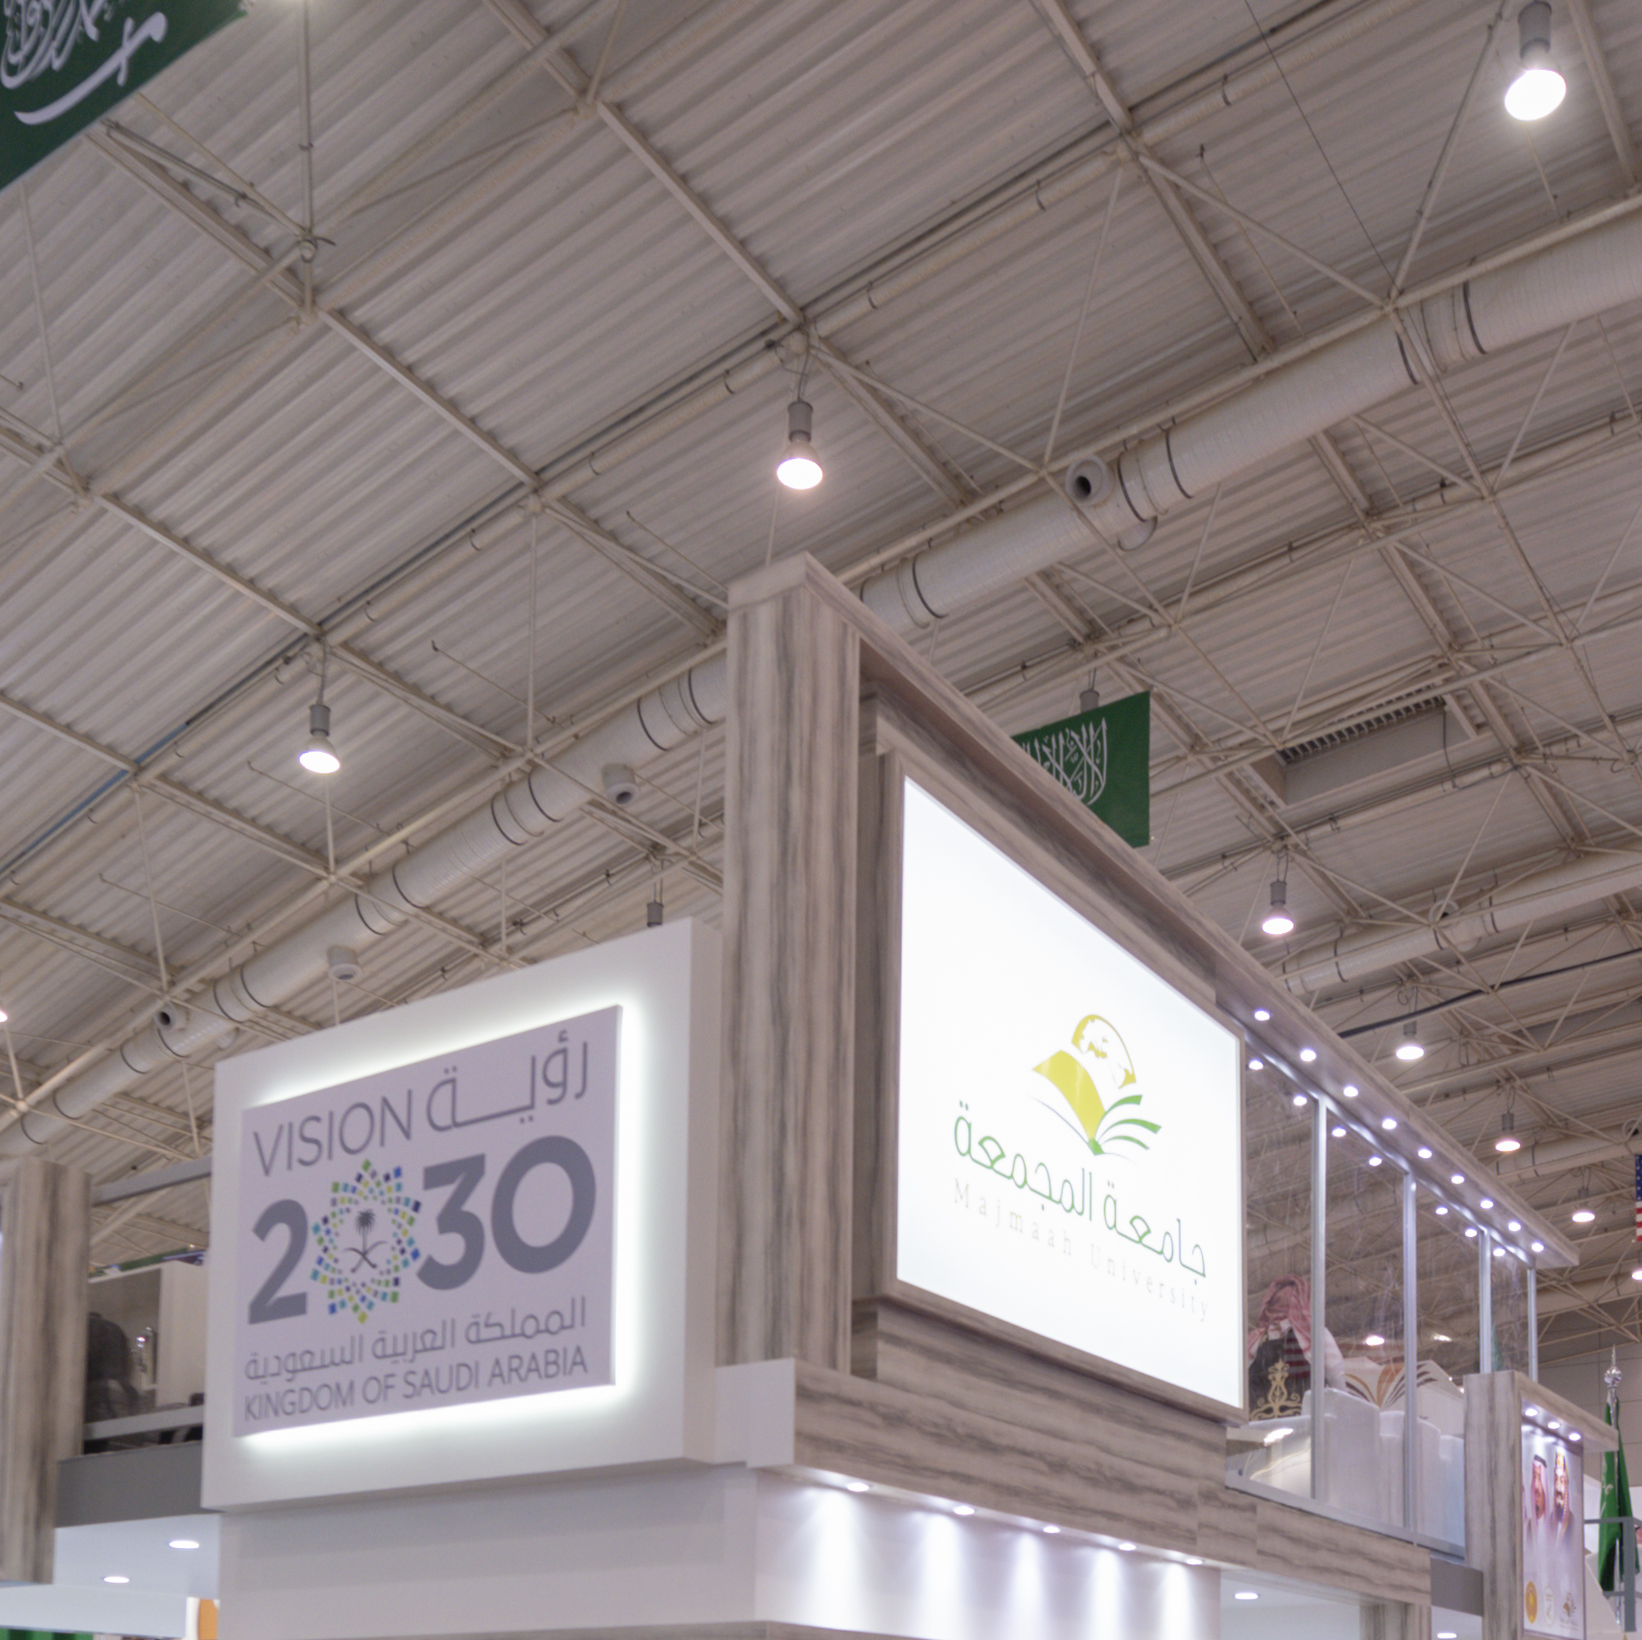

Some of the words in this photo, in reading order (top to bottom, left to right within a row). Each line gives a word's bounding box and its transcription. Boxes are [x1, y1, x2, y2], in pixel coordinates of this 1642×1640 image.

[253, 1089, 413, 1177] VISION
[953, 1100, 1093, 1222] المجمعة
[953, 1177, 1072, 1256] Majmaah
[1090, 1242, 1210, 1322] University
[1103, 1180, 1207, 1286] جامعة
[244, 1334, 363, 1386] السعودية
[371, 1318, 456, 1367] العربية
[465, 1296, 586, 1346] المملكة
[244, 1381, 354, 1422] KINGDOM
[361, 1373, 397, 1405] OF
[402, 1359, 481, 1399] SAUDI
[487, 1345, 588, 1387] ARABIA
